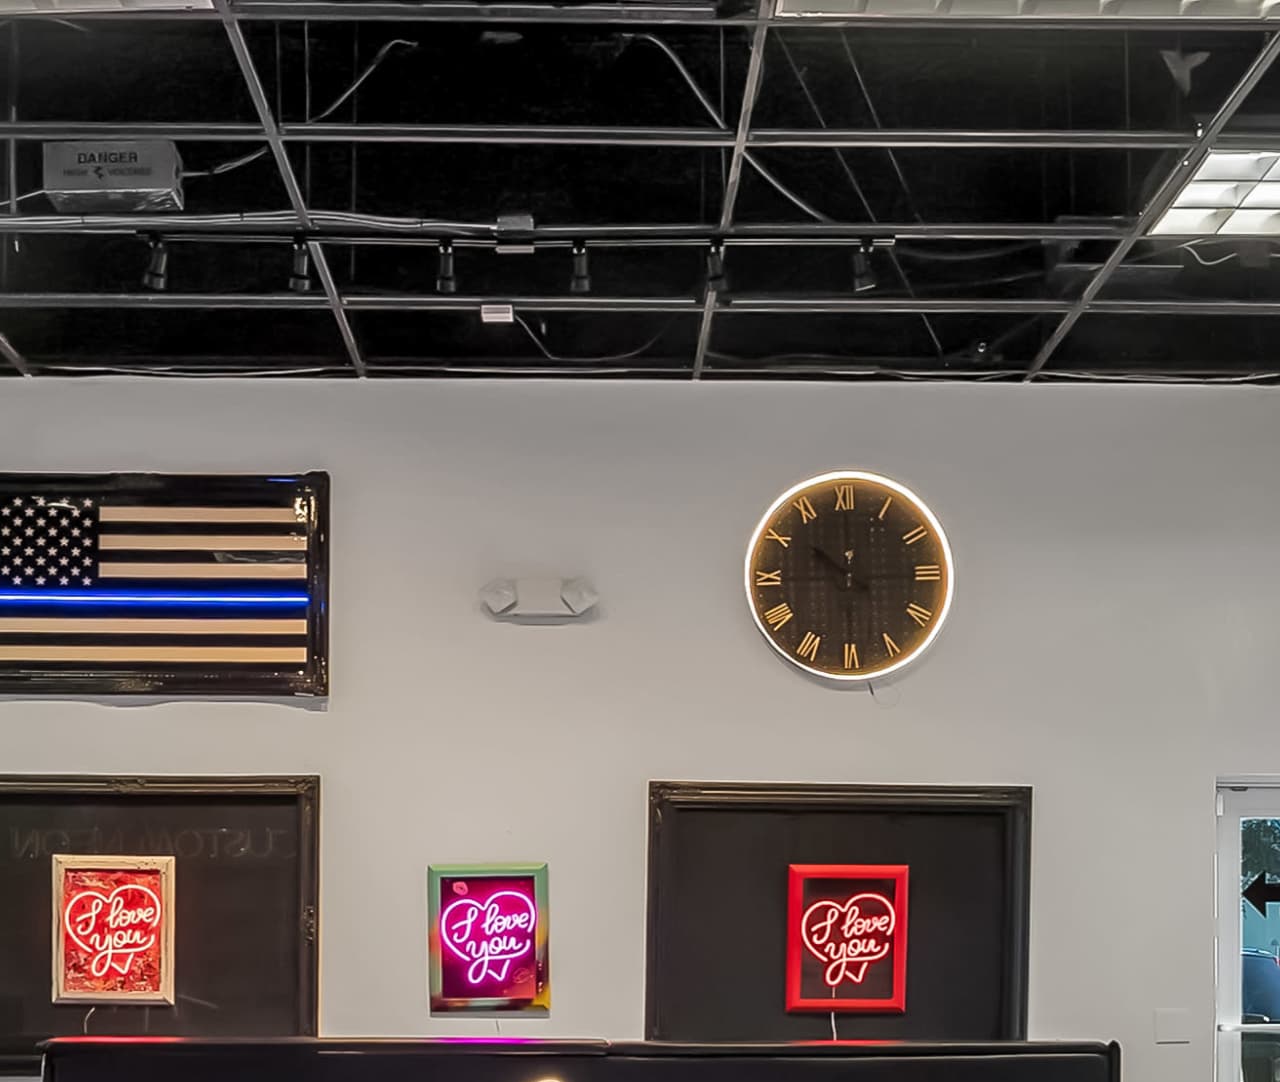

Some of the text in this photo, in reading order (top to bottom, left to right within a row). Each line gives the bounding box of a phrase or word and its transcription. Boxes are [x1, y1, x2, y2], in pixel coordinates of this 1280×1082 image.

[77, 151, 139, 164] DANGER
[107, 896, 155, 929] love
[481, 902, 530, 936] love
[840, 905, 890, 938] love
[89, 928, 148, 977] you
[465, 935, 523, 984] you
[824, 938, 882, 986] you
